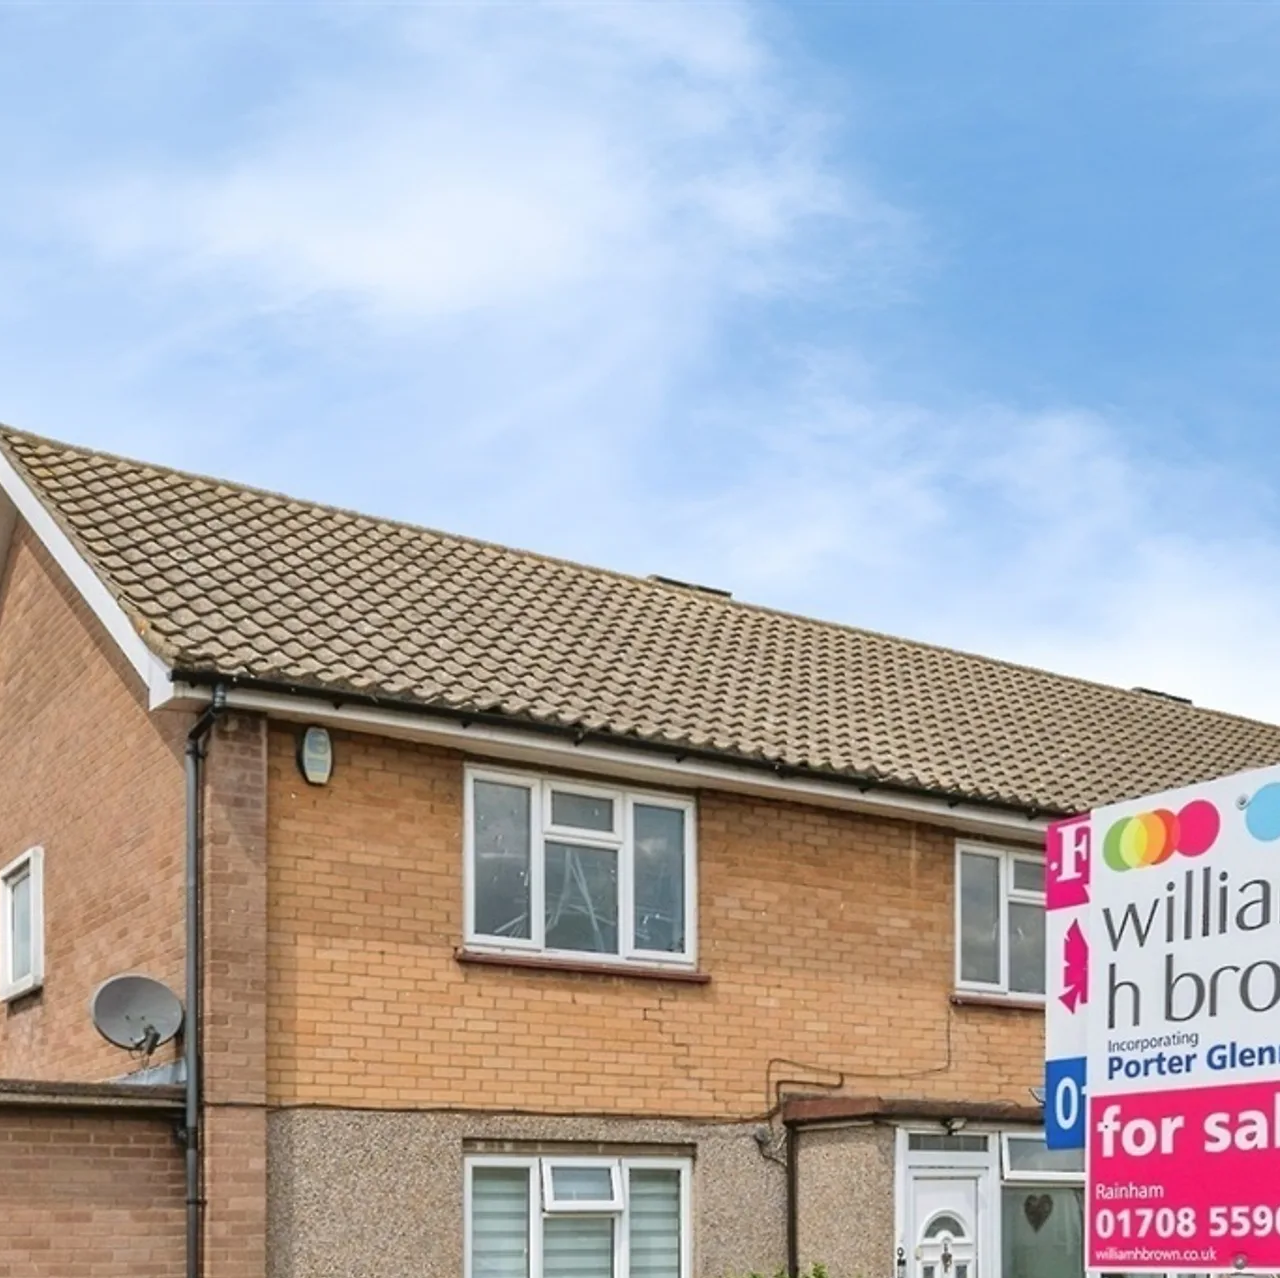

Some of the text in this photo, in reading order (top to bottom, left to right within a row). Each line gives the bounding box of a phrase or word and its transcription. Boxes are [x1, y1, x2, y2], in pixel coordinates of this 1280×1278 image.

[1107, 963, 1140, 1029] h
[1107, 1032, 1199, 1053] Incorporating
[1108, 1052, 1197, 1080] Porter
[1097, 1105, 1185, 1158] for
[1096, 1181, 1164, 1200] Rainham
[1096, 1207, 1197, 1239] 01708
[1096, 1247, 1217, 1262] williamhbrown.co.uk
